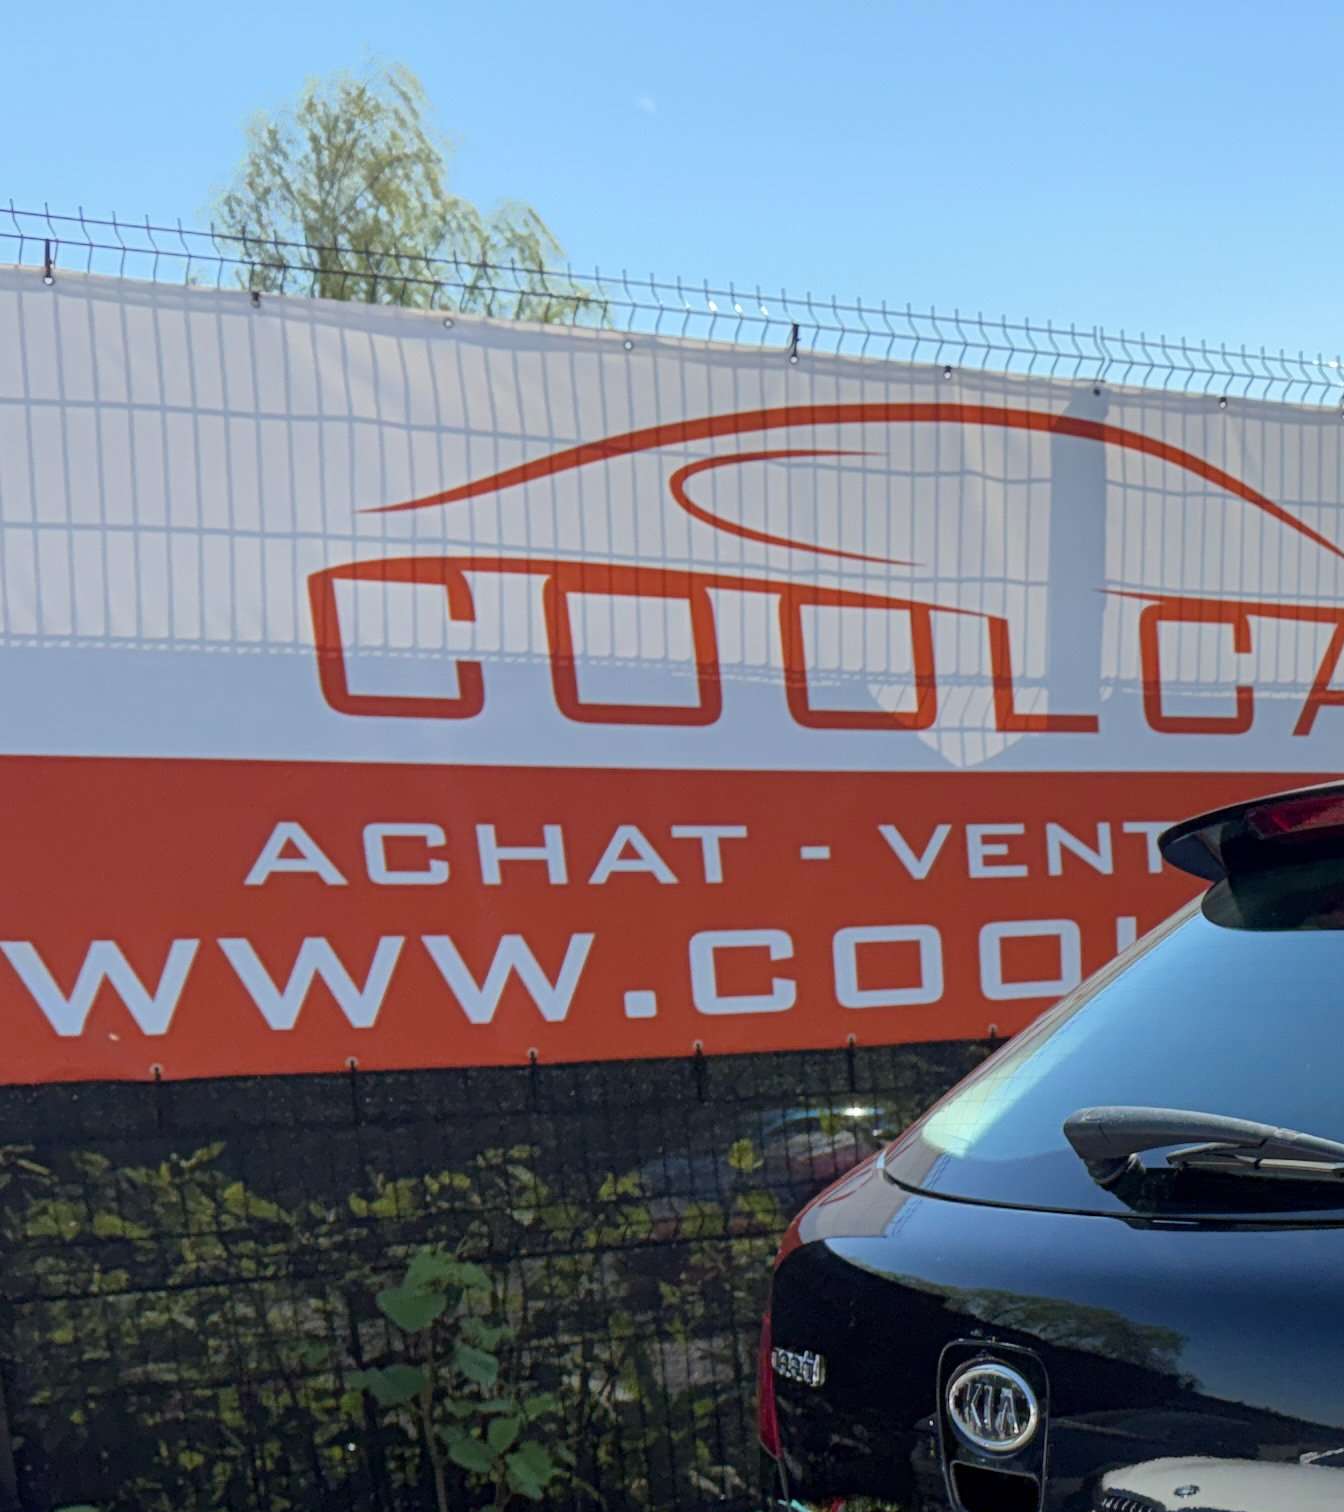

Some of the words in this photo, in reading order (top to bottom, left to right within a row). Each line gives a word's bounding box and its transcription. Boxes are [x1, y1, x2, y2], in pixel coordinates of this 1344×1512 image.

[307, 556, 1099, 733] COOL
[243, 820, 748, 886] ACHAT
[964, 1382, 1020, 1440] KIA
